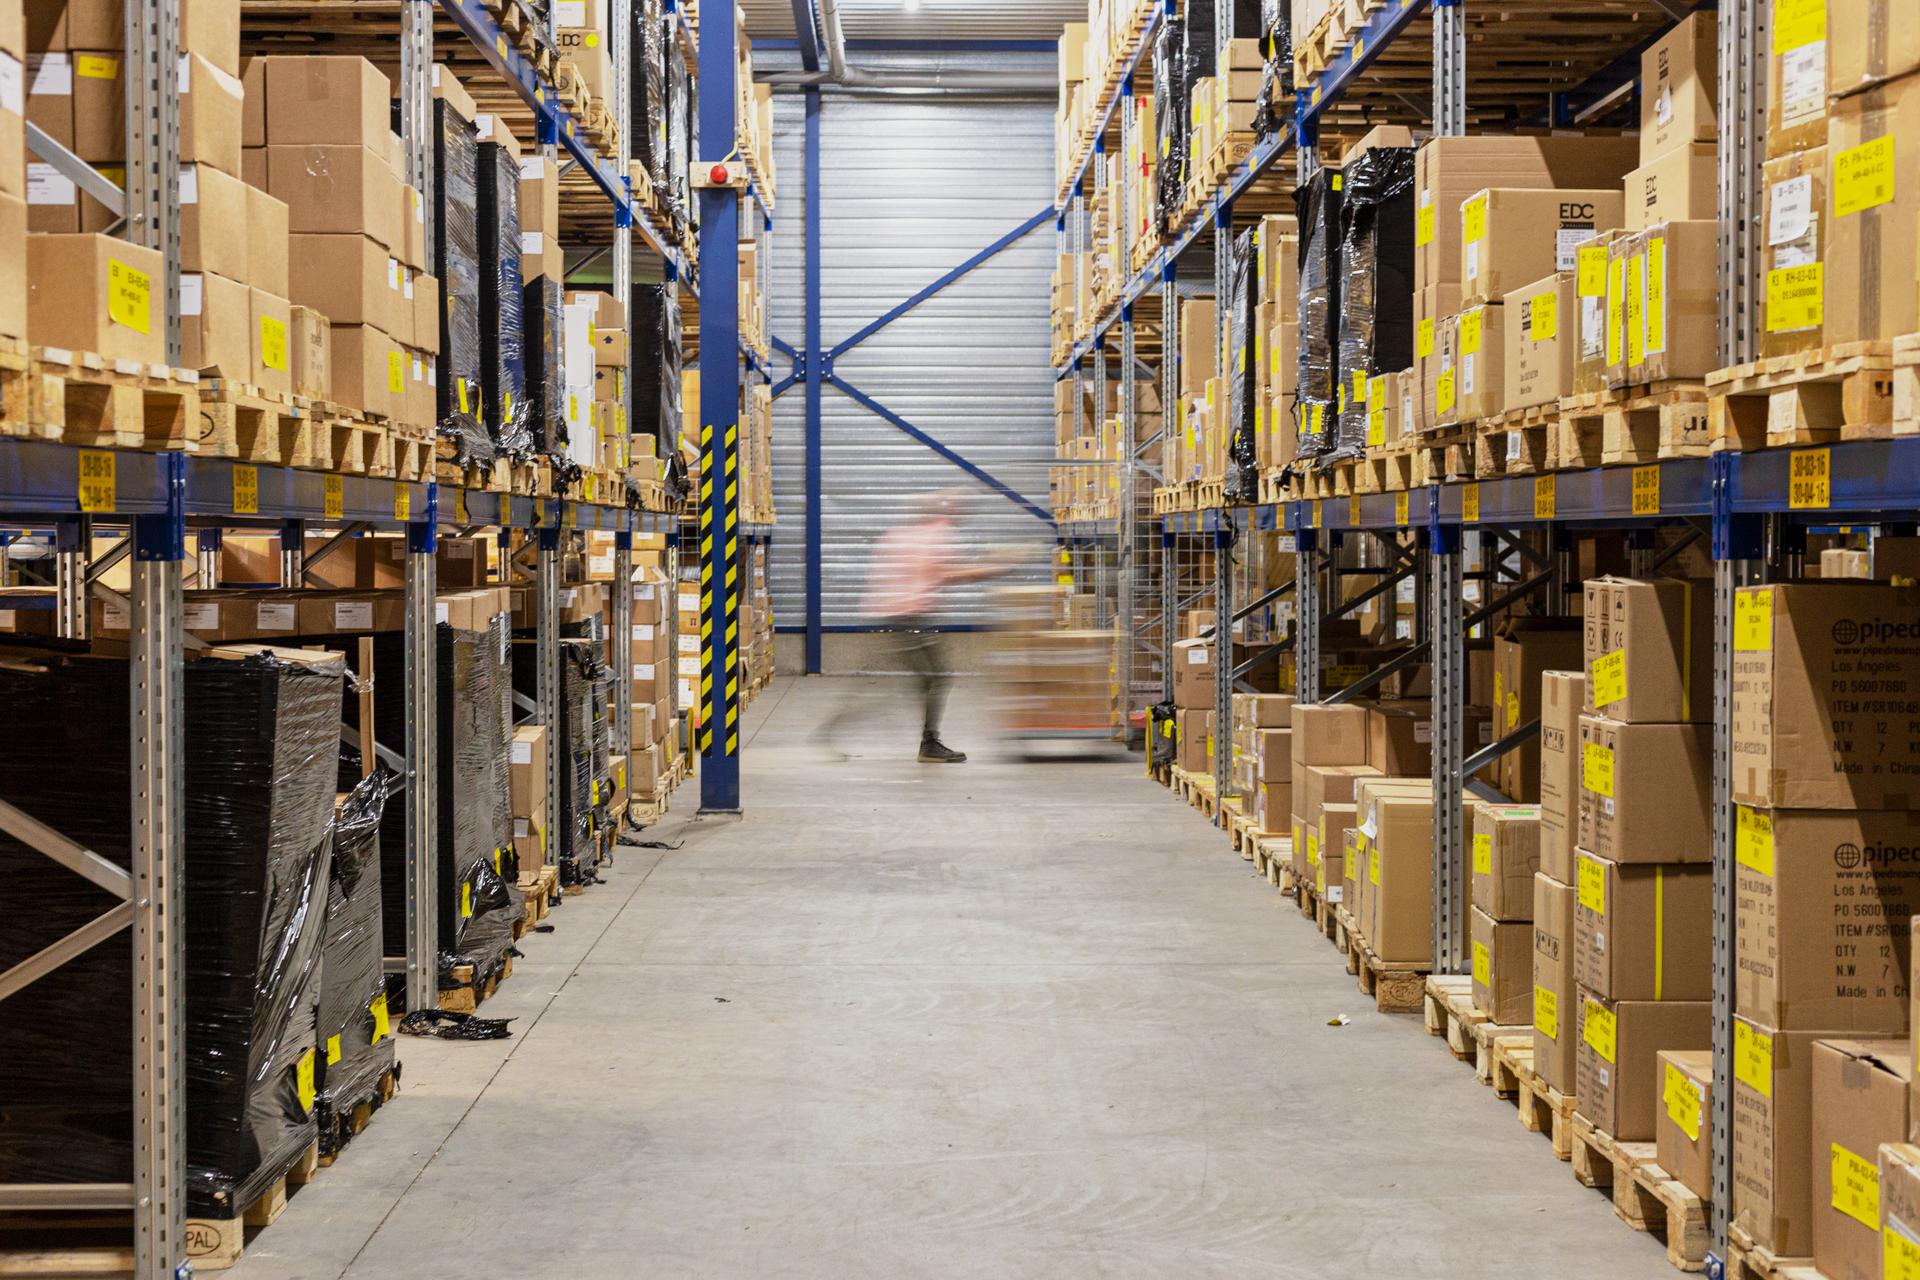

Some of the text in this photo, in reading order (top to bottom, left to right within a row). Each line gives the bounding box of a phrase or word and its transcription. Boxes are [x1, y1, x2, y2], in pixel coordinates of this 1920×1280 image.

[1560, 203, 1594, 219] EDC
[1794, 454, 1825, 477] 30-03-16
[1794, 482, 1825, 503] 30-04-16
[1832, 661, 1901, 675] Los Angeles
[1832, 681, 1907, 693] PO 56007660
[1833, 700, 1859, 713] ITEM
[1877, 721, 1888, 734] 12
[1878, 741, 1886, 756] 7
[1834, 760, 1864, 774] Made
[1872, 761, 1882, 773] in
[1834, 884, 1903, 899] Los Angeles
[1834, 904, 1910, 917] PO 56007660
[1836, 924, 1910, 937] ITEM #SR106
[1880, 945, 1891, 958] 12
[1882, 964, 1890, 980] 7
[1836, 985, 1867, 998] Made
[1876, 985, 1886, 998] in
[185, 1231, 214, 1248] PAL
